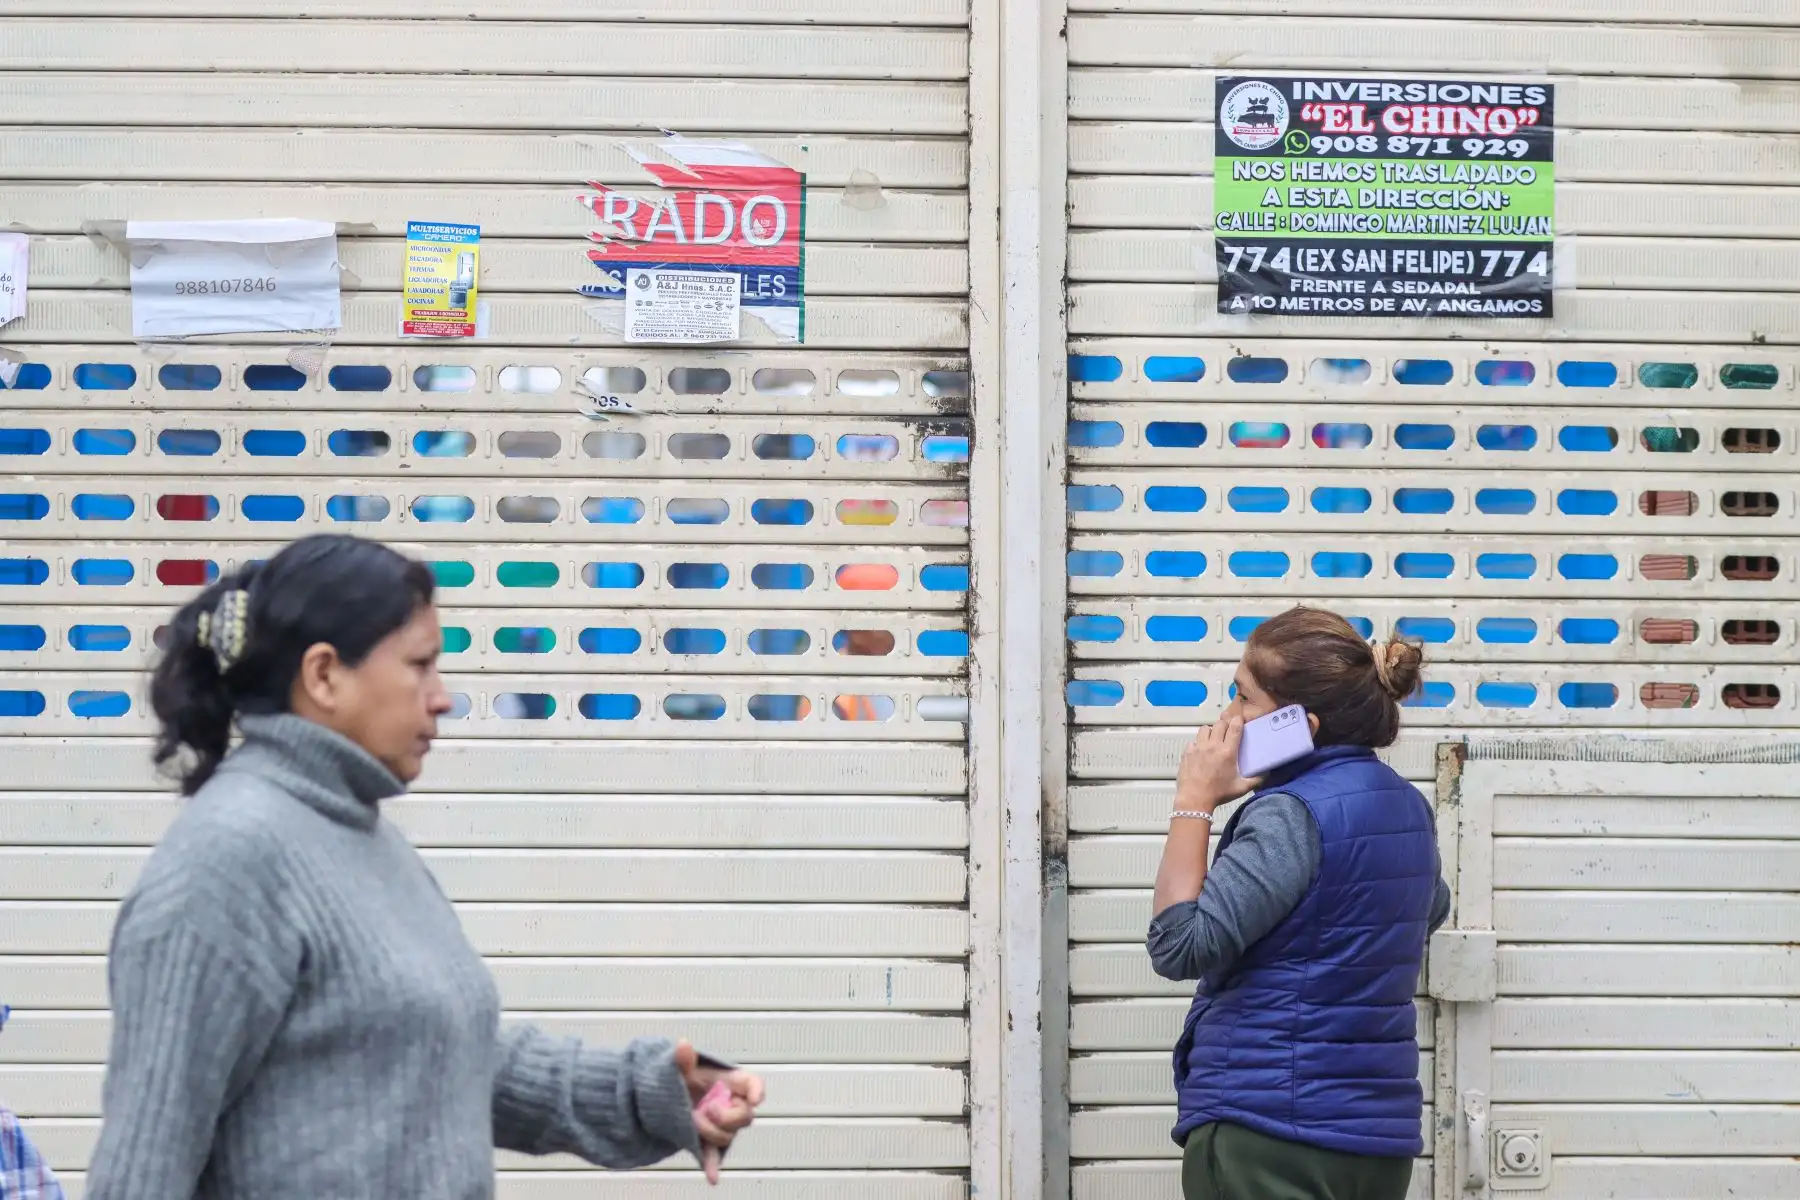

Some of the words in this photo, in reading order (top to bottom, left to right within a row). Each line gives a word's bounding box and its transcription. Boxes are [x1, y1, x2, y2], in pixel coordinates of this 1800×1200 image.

[1227, 83, 1260, 103] INVERSIONES
[1270, 87, 1285, 104] CHINO
[1293, 81, 1546, 105] INVERSIONES
[1311, 135, 1378, 155] 908
[1387, 135, 1452, 156] 871
[1462, 138, 1529, 158] 929
[1233, 160, 1285, 181] NOS
[1291, 161, 1377, 182] HEMOS
[1381, 162, 1536, 185] TRASLADADO
[1261, 187, 1283, 207] A
[1288, 187, 1353, 208] ESTA
[1358, 184, 1510, 211] DIRECCIÓN:
[410, 225, 478, 235] MULTISERVICIOS
[1216, 211, 1276, 231] CALLE
[1290, 212, 1383, 233] DOMINGO
[1386, 213, 1484, 234] MARTINEZ
[1488, 215, 1552, 236] LUJAN
[1224, 246, 1291, 273] 774
[1296, 248, 1336, 272] (EX
[1341, 248, 1386, 273] SAN
[1392, 249, 1475, 274] FELIPE)
[1480, 250, 1547, 277] 774
[0, 273, 11, 281] do
[175, 277, 276, 295] 988107846
[656, 281, 678, 290] A&J
[709, 285, 735, 293] S.A.C.
[658, 275, 734, 284] DISTRIBUCIONES
[744, 274, 786, 297] LES
[1290, 279, 1366, 293] FRENTE
[1372, 280, 1387, 294] A
[1392, 281, 1481, 294] SEDAPAL
[1230, 296, 1245, 309] A
[1251, 295, 1276, 309] 10
[1280, 297, 1364, 311] METROS
[1370, 298, 1395, 312] DE
[1401, 298, 1431, 312] AV.
[1437, 299, 1543, 313] ANGAMOS
